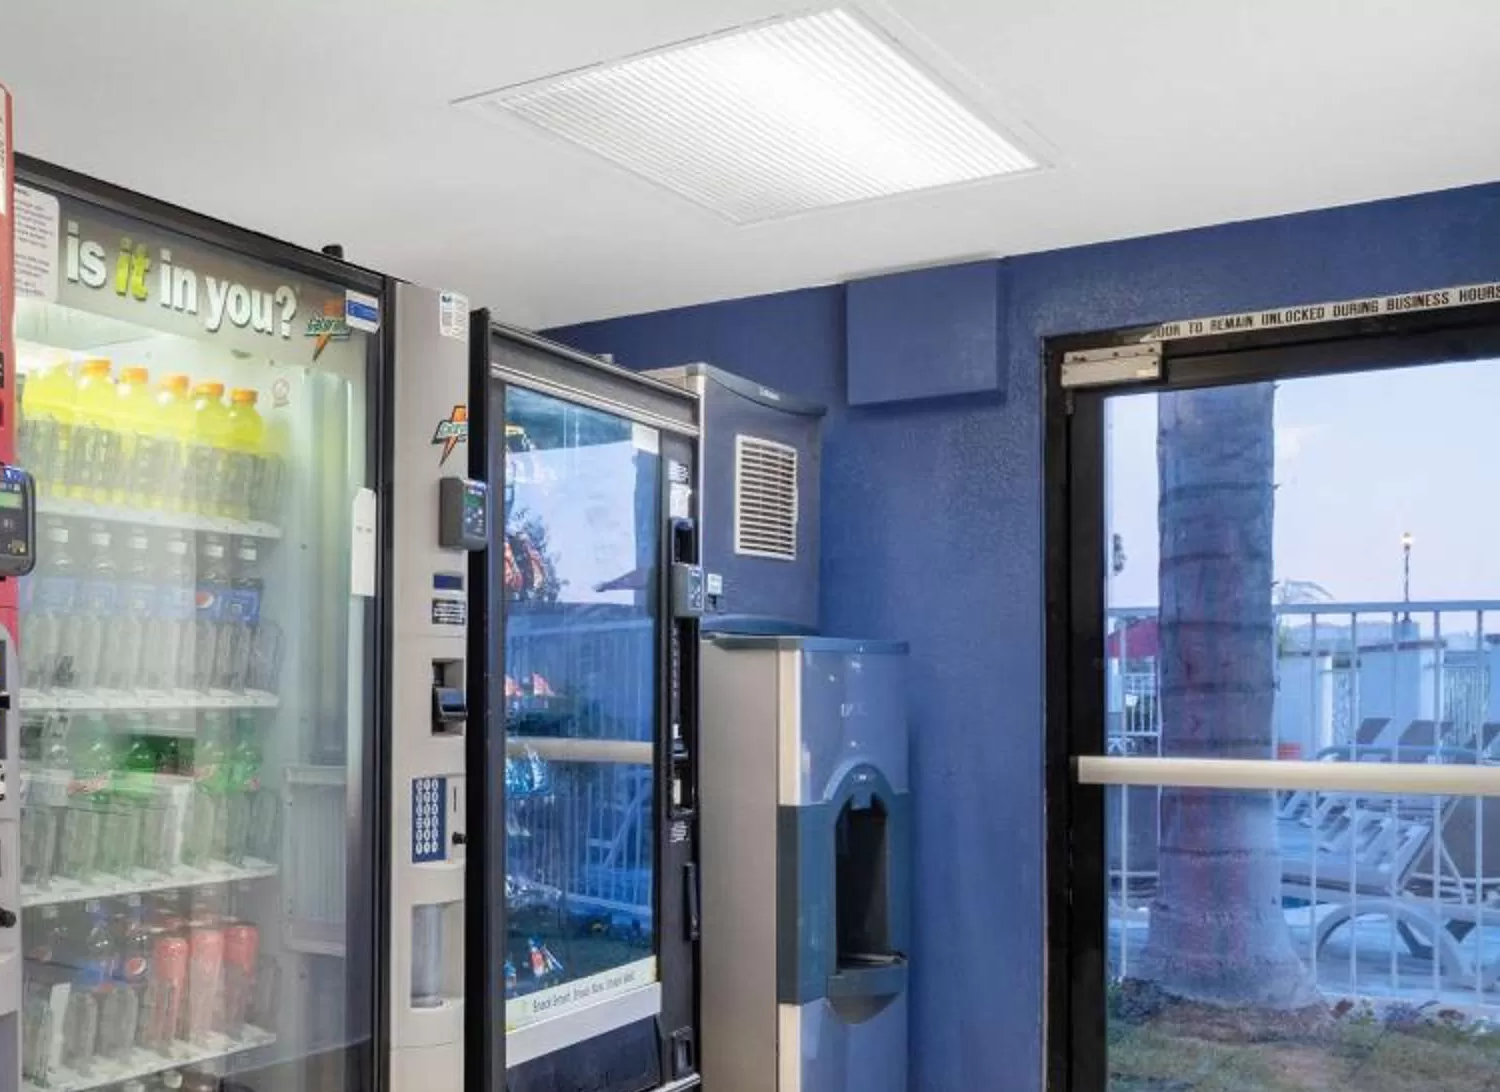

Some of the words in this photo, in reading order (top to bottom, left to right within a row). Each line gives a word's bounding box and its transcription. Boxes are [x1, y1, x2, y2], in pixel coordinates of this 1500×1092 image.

[67, 220, 107, 288] is
[116, 236, 151, 301] it
[160, 248, 198, 315] in
[204, 284, 298, 340] you?
[1188, 321, 1203, 335] TO
[1210, 315, 1254, 332] REMAIN
[1261, 307, 1325, 325] UNLOCKED
[1333, 300, 1379, 317] DURING
[1386, 291, 1449, 311] BUSINESS
[1459, 284, 1500, 303] HOURS
